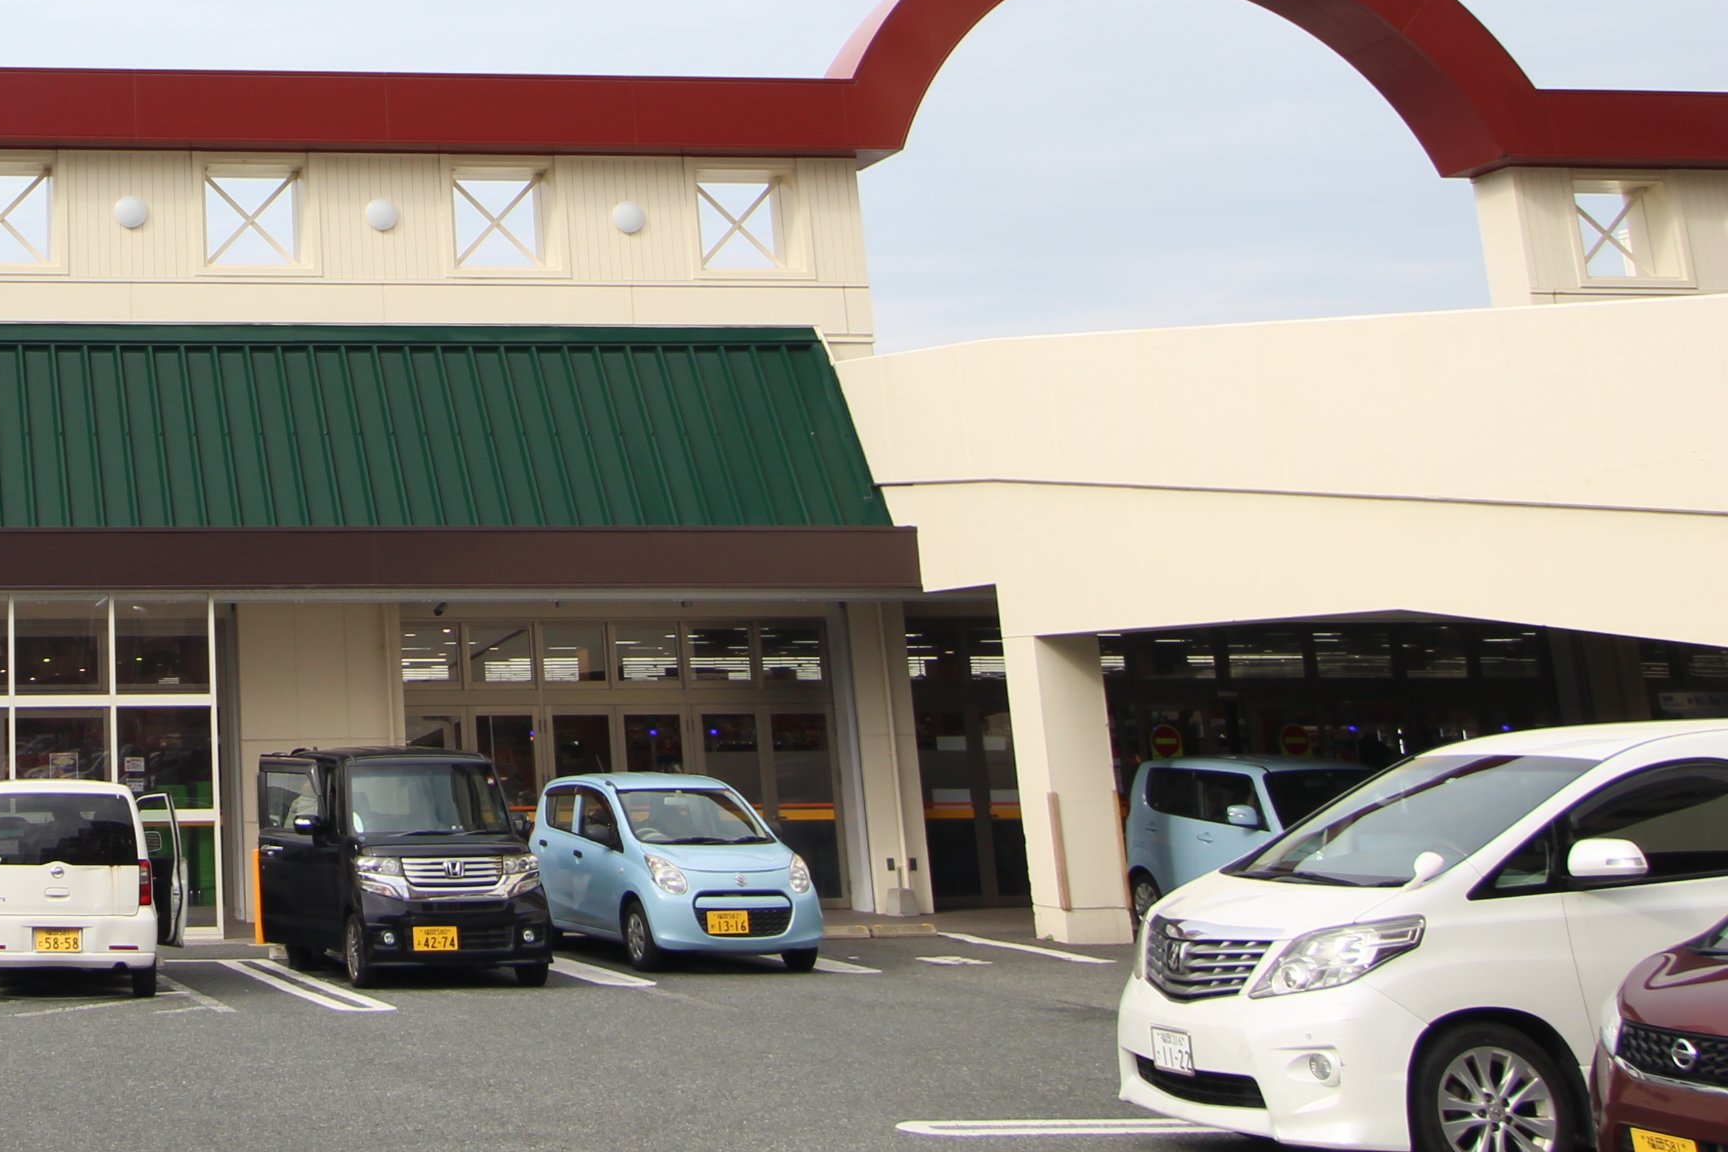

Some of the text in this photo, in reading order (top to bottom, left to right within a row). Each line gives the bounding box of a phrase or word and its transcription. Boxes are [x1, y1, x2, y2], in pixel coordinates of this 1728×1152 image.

[718, 920, 747, 932] 13-16
[44, 937, 79, 950] 58-58
[423, 936, 456, 949] 42-74
[1162, 1045, 1193, 1071] 11-22
